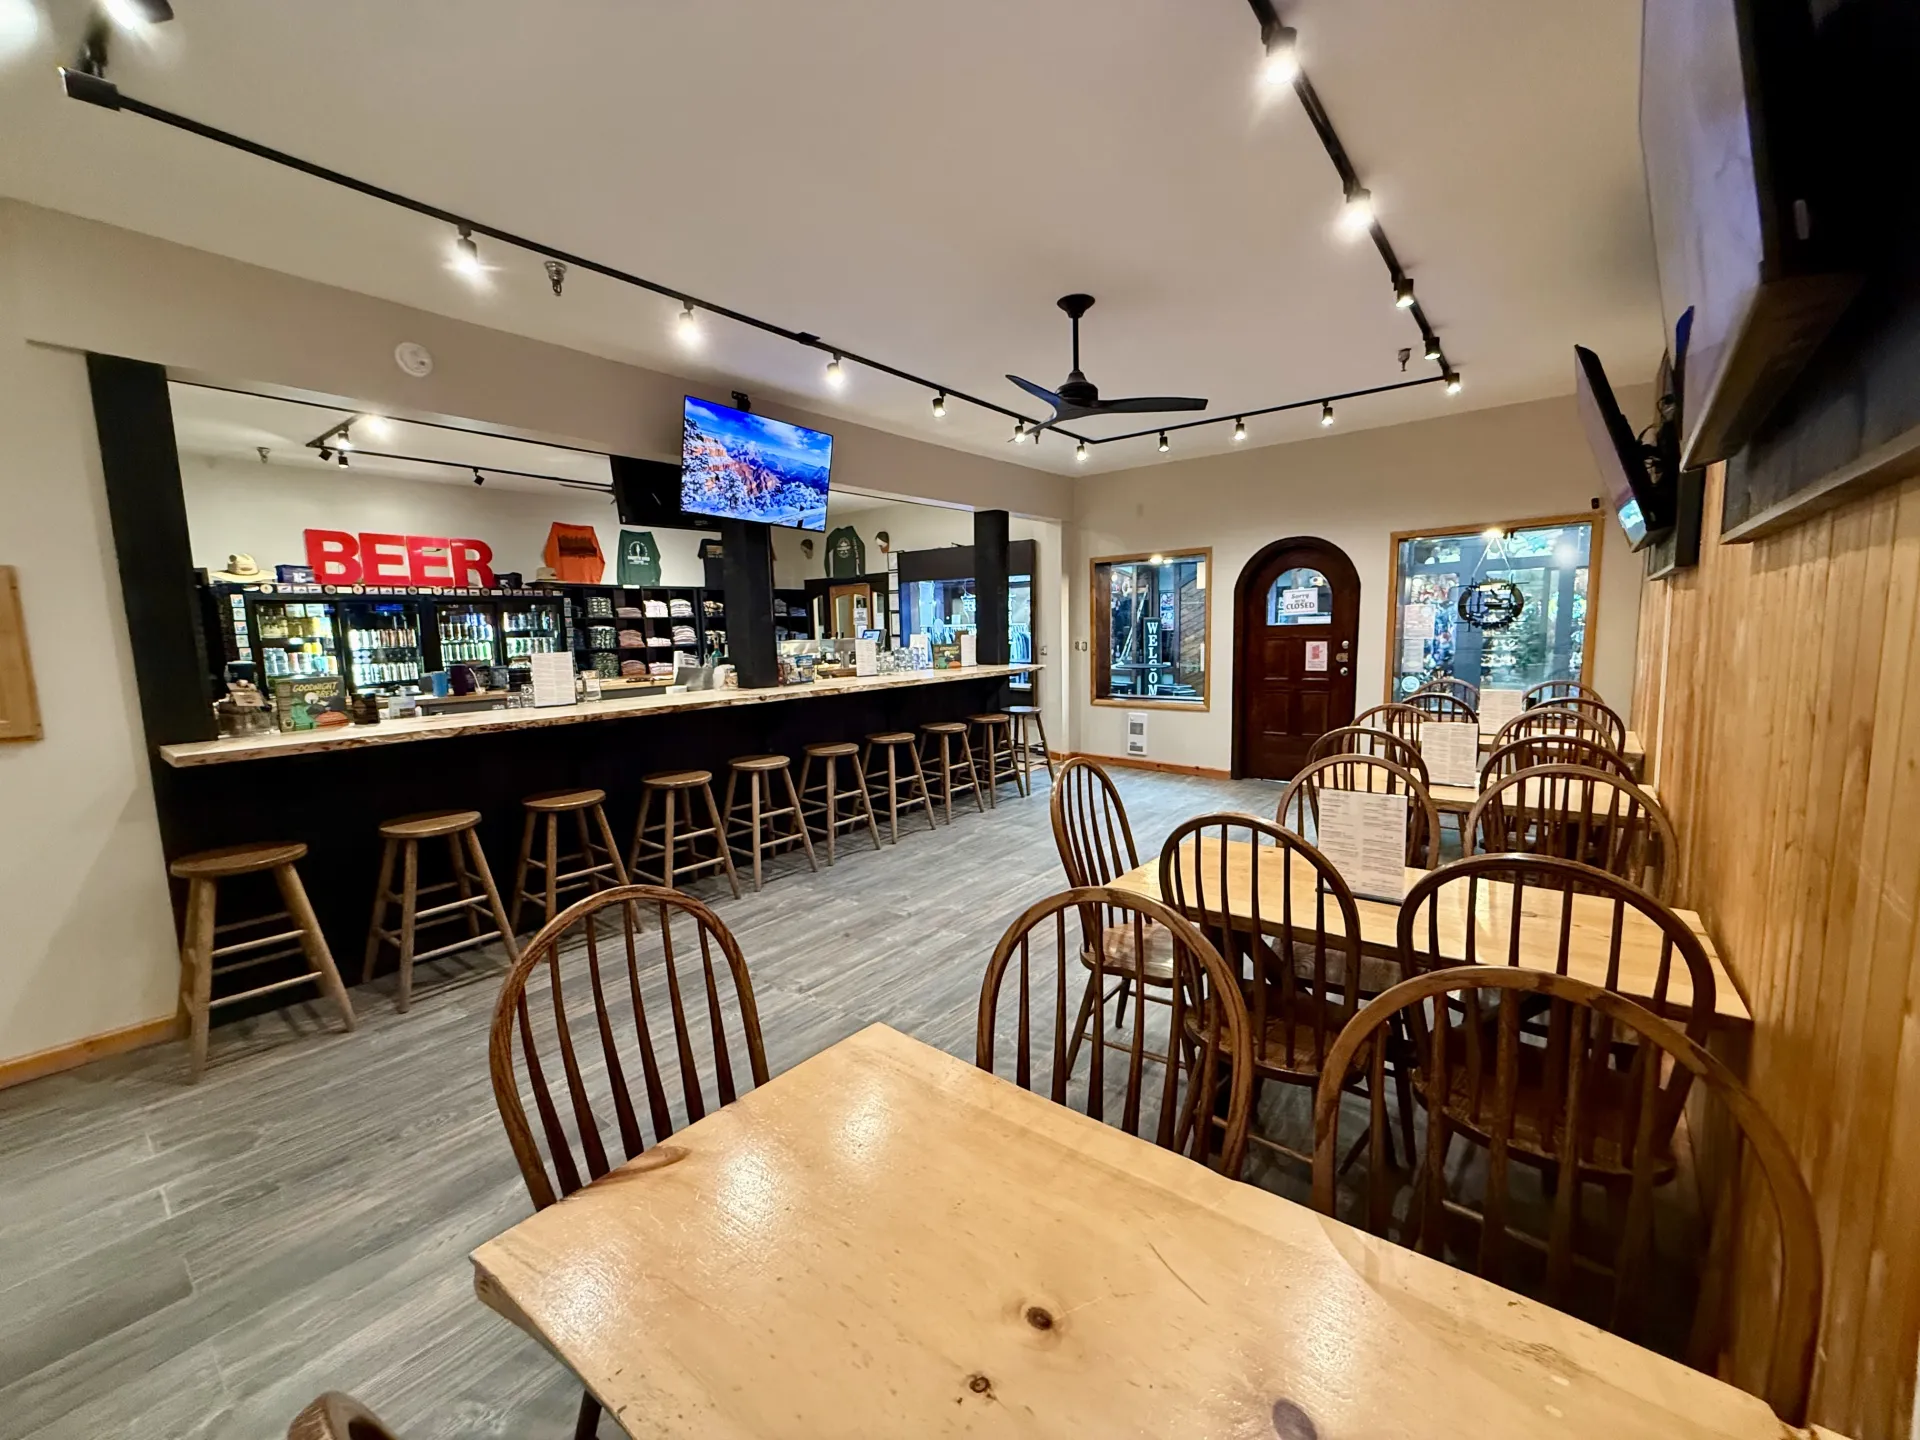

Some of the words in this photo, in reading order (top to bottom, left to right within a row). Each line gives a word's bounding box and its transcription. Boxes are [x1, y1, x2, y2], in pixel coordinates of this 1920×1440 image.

[303, 529, 496, 587] BEER
[1286, 602, 1315, 610] CLOSED
[1147, 622, 1158, 696] WELCOM
